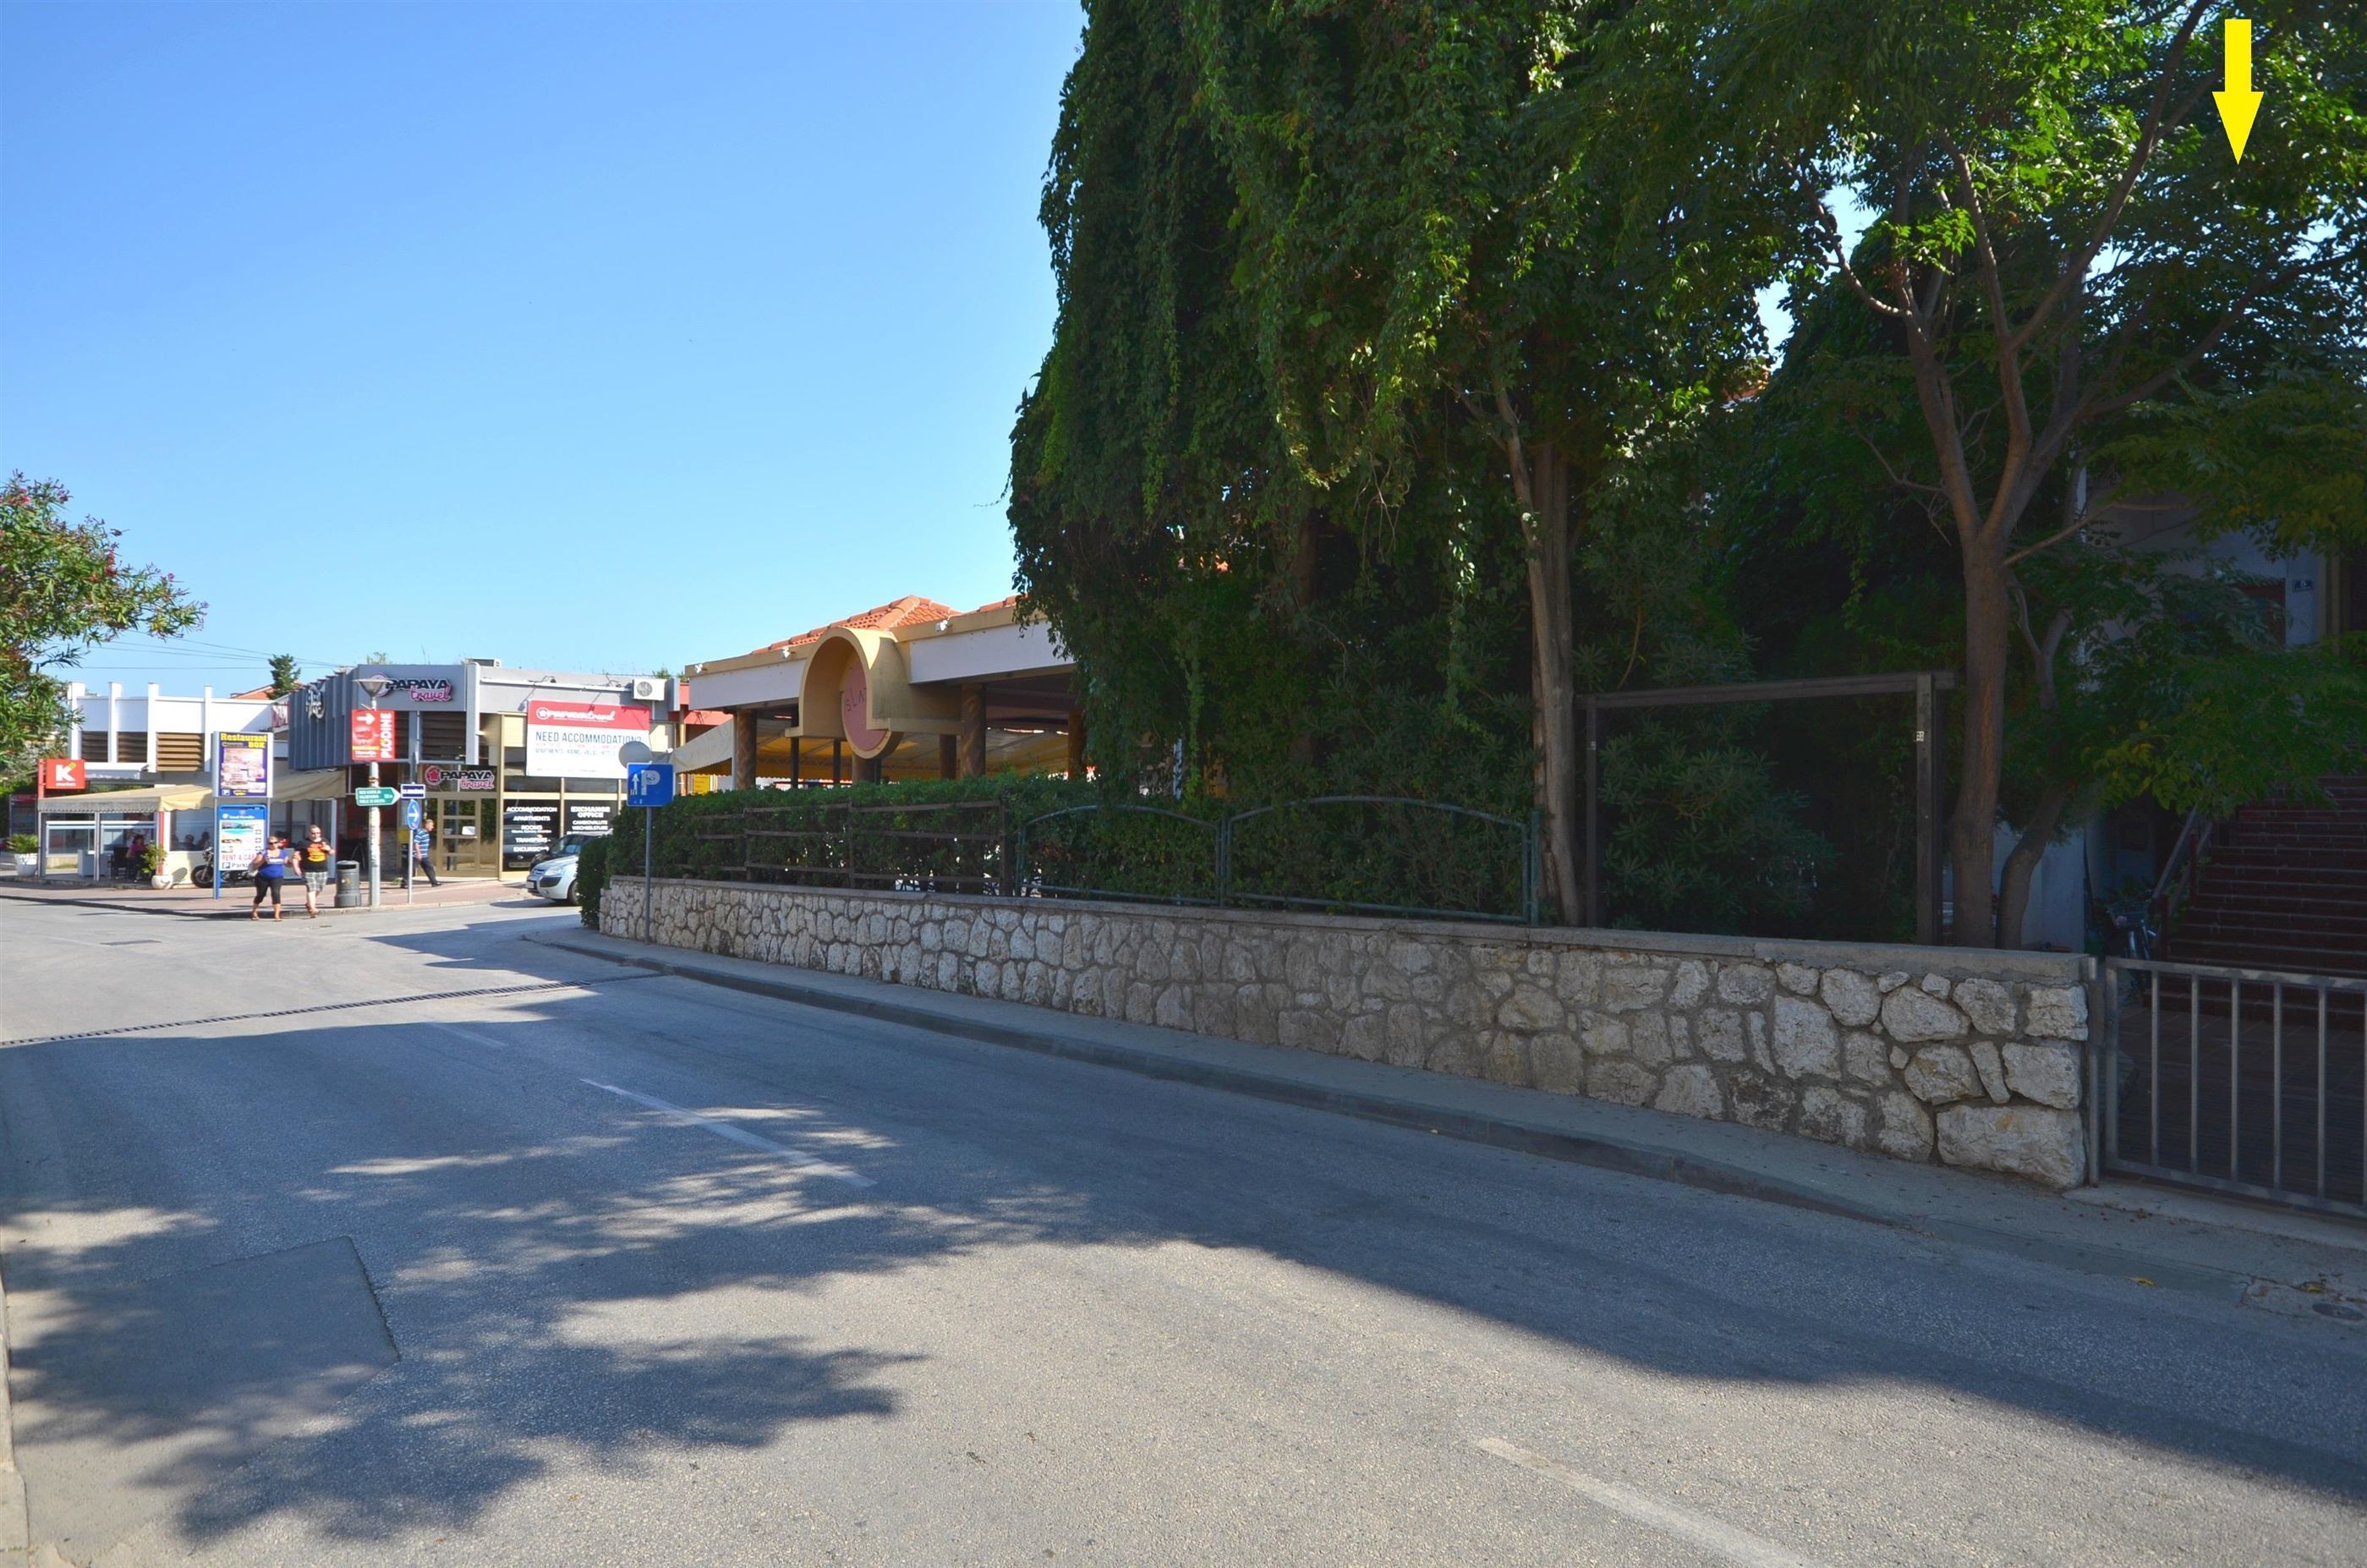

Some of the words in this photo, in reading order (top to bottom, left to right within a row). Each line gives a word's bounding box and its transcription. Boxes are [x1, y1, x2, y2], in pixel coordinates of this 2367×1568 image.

[386, 679, 447, 689] PAPAYA
[410, 683, 451, 701] travel
[221, 733, 267, 742] Restaurant
[381, 713, 392, 758] PLODINE
[535, 732, 559, 742] NEED
[562, 732, 642, 745] ACCOMMODATION?
[56, 762, 76, 781] K
[441, 770, 492, 780] PAPAYA
[462, 777, 494, 788] travel
[641, 770, 660, 795] P
